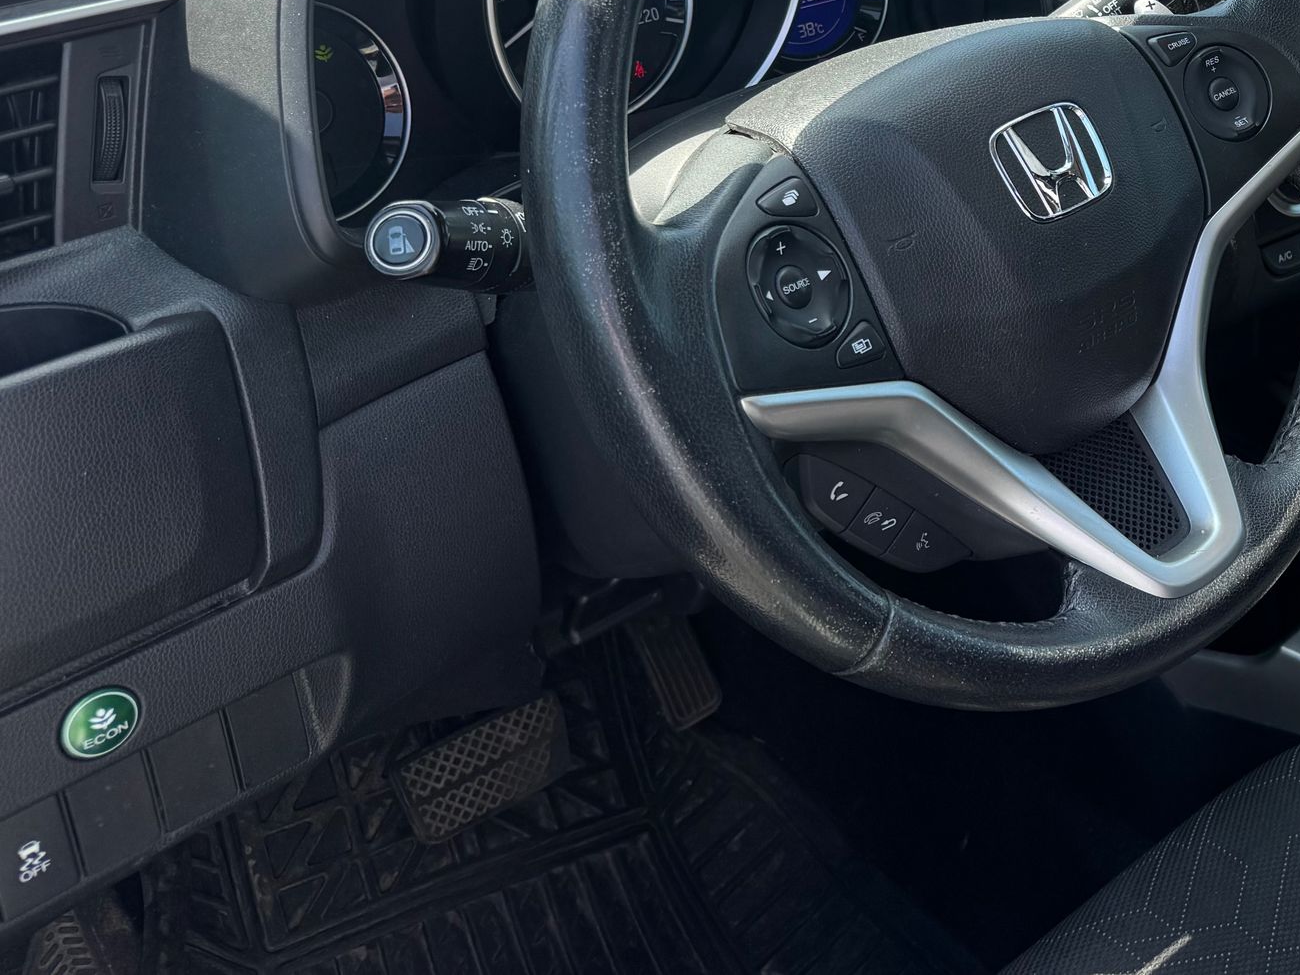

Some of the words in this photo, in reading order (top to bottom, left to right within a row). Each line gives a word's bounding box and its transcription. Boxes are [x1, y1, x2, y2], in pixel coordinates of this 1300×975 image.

[1167, 37, 1191, 51] CRUISE
[1205, 56, 1220, 67] RES
[1213, 87, 1237, 102] CANCEL
[1234, 117, 1249, 128] SET
[465, 240, 488, 252] AUTO
[1278, 250, 1293, 263] A/C
[783, 277, 810, 295] SOURCE
[82, 720, 129, 751] ECON
[19, 859, 51, 883] OFF
